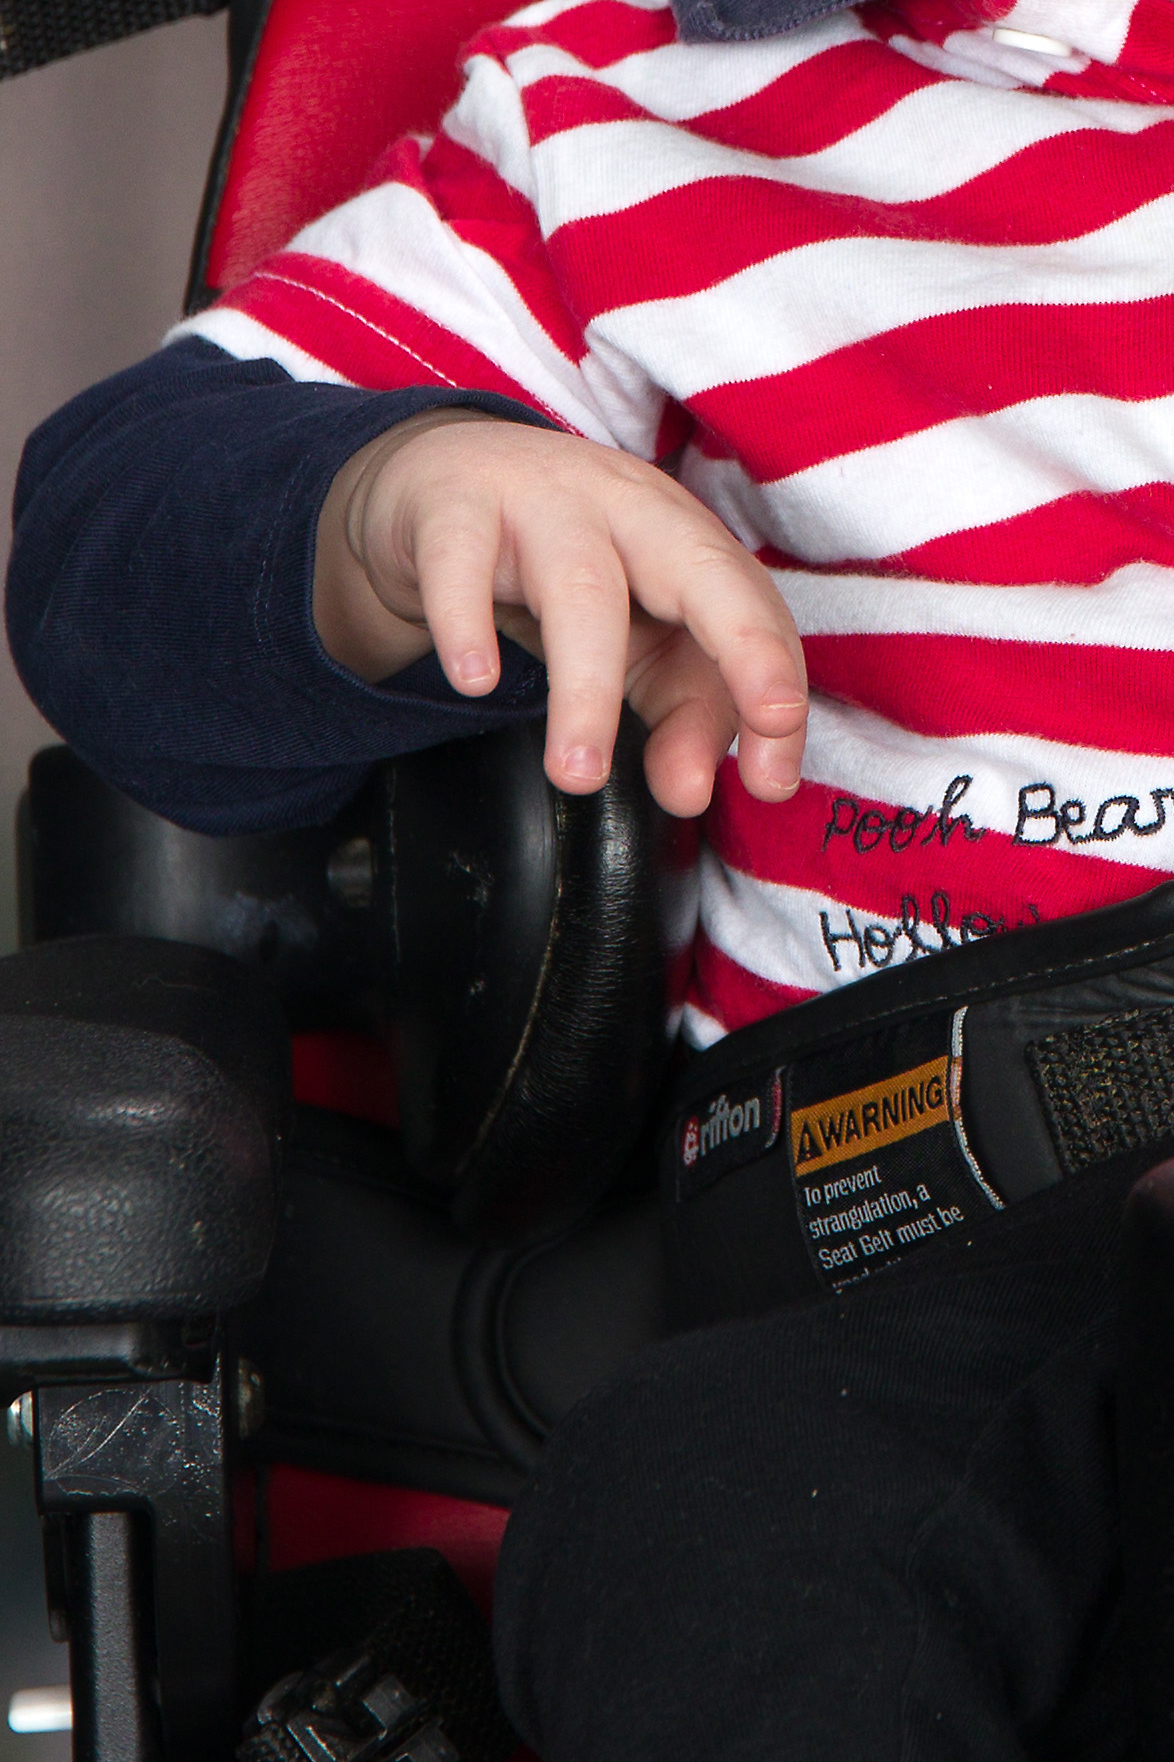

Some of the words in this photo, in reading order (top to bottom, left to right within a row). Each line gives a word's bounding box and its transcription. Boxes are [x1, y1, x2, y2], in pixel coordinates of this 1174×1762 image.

[818, 891, 1039, 972] Hollo
[818, 1076, 946, 1149] WARNING
[803, 1186, 822, 1207] To
[822, 1164, 882, 1205] prevent
[808, 1190, 919, 1240] strangulation,
[916, 1182, 932, 1202] a
[818, 1241, 858, 1270] Seat
[895, 1213, 942, 1245] must
[936, 1205, 965, 1227] be
